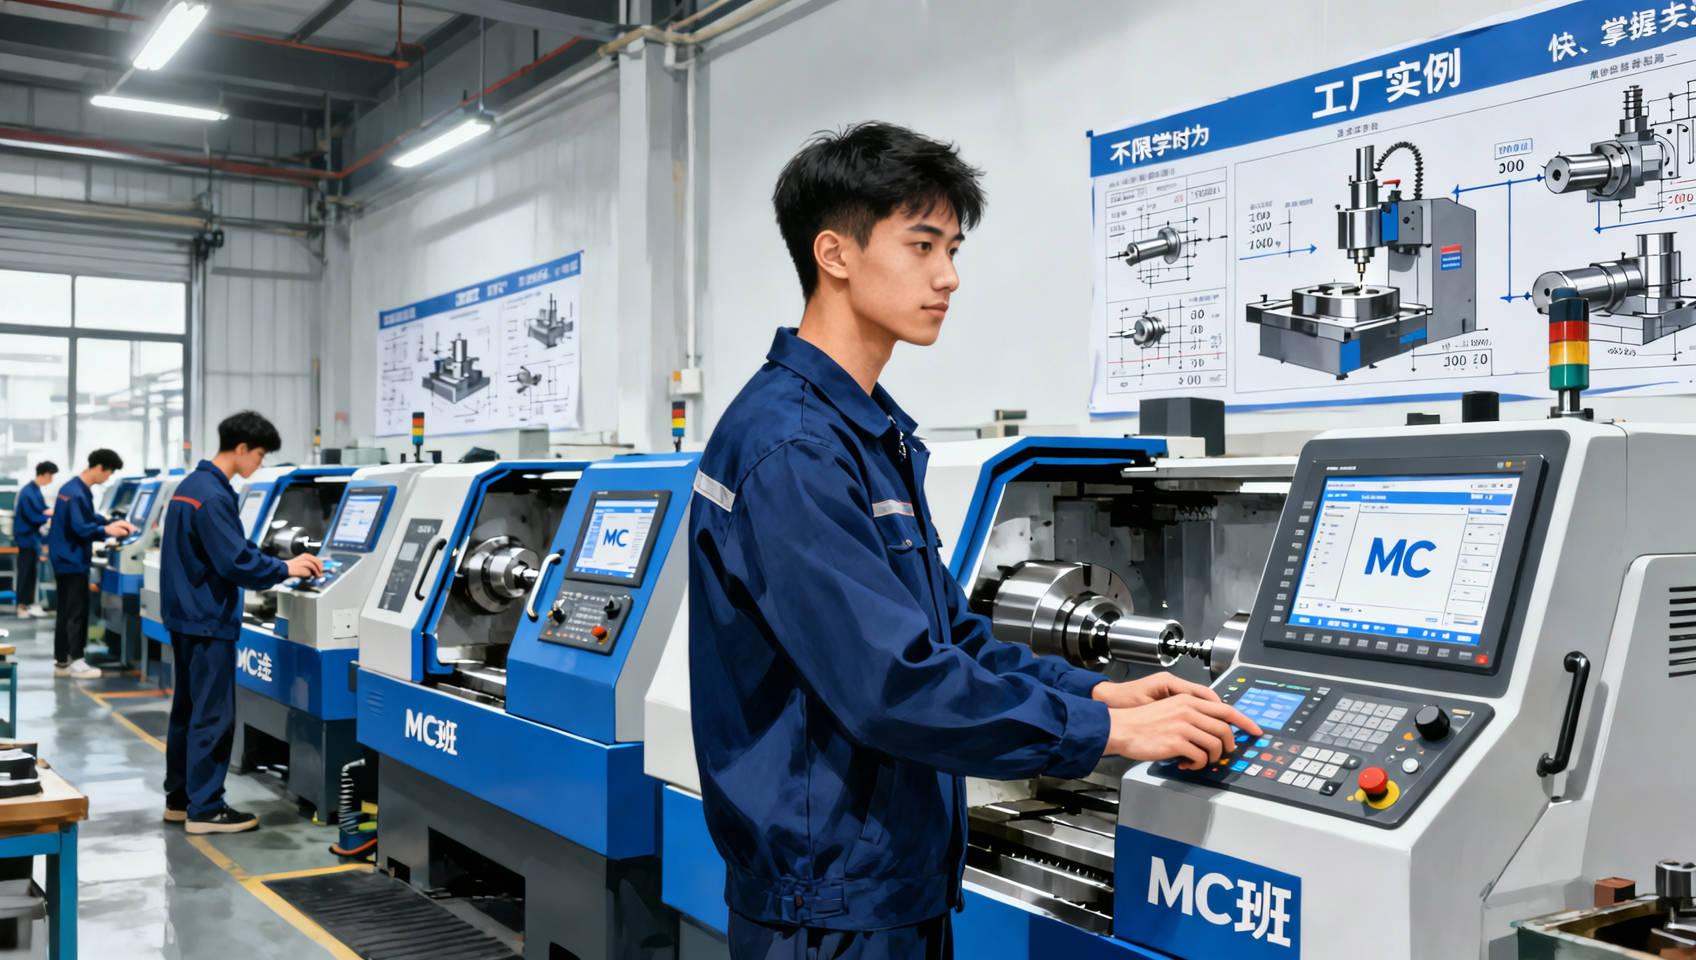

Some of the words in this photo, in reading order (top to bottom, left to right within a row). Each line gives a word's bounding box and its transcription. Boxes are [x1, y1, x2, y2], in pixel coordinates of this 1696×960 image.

[1312, 48, 1461, 119] 工厂实例
[603, 528, 629, 547] MC
[1363, 537, 1437, 578] MC
[405, 708, 458, 756] MC班
[1147, 856, 1292, 947] MC班
